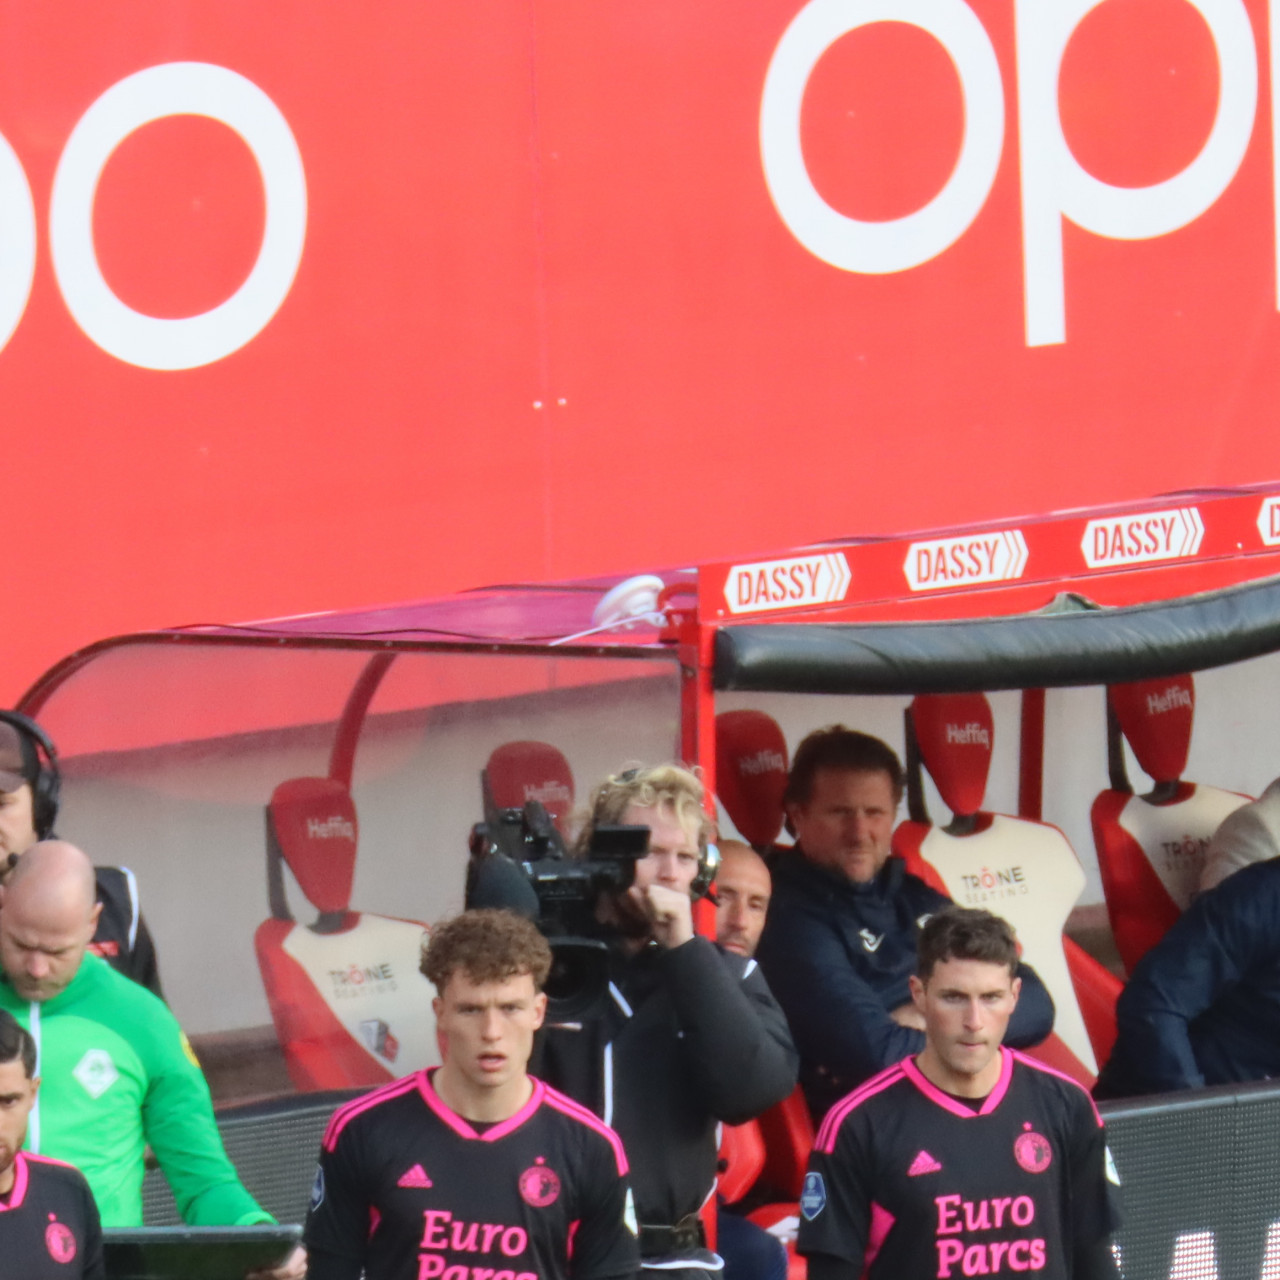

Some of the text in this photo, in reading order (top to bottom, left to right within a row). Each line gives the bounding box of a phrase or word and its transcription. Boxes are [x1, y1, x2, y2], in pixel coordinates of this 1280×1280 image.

[1093, 517, 1176, 561] DASSY
[737, 562, 820, 606] DASSY
[916, 540, 999, 584] DASSY
[946, 722, 990, 750] Heffiq
[420, 1209, 528, 1257] Euro
[934, 1193, 1036, 1236] Euro
[934, 1237, 1047, 1279] Parcs
